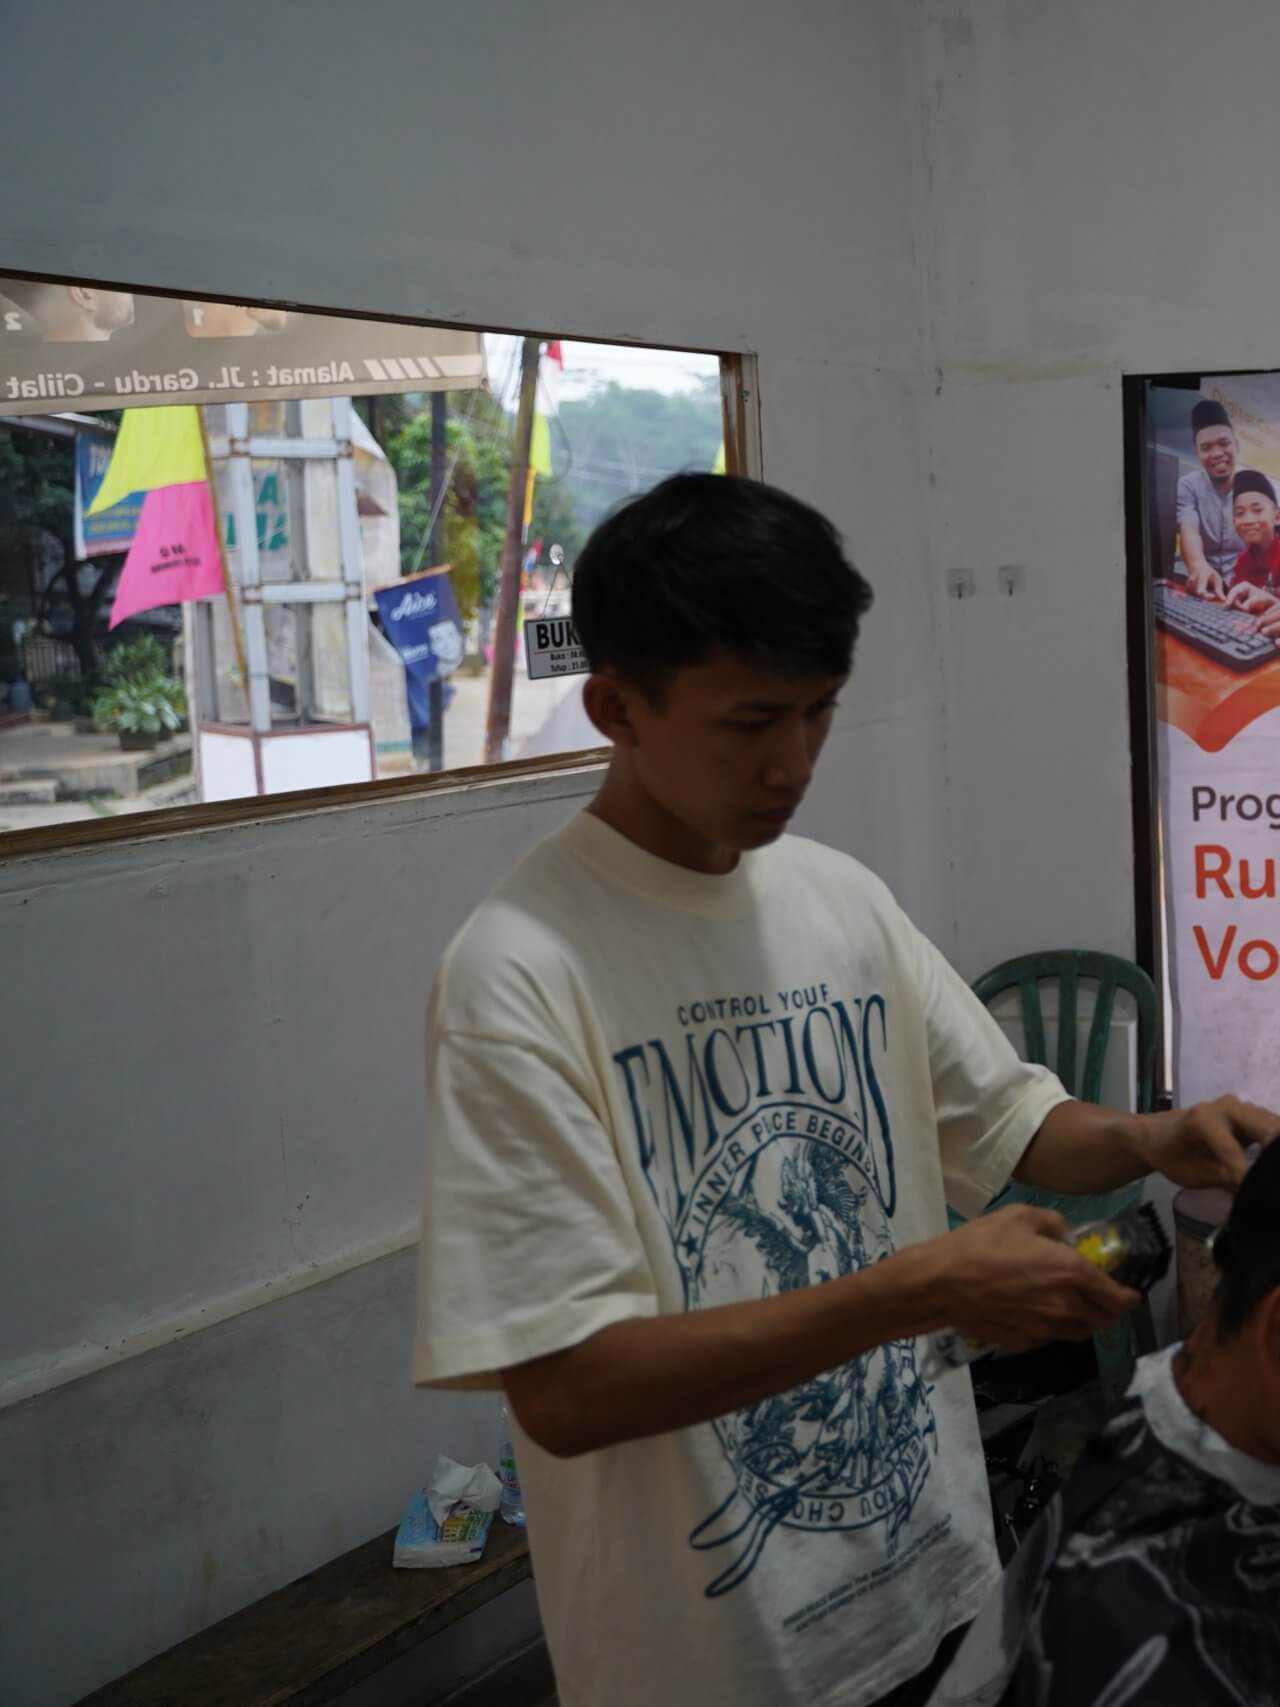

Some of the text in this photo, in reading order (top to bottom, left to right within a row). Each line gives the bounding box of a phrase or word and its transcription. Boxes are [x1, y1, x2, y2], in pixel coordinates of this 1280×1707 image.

[536, 622, 580, 649] BUK
[676, 994, 772, 1027] CONTROL
[613, 994, 896, 1218] EMOTIONS
[692, 1141, 746, 1226] INNER
[751, 1111, 797, 1143] PCE
